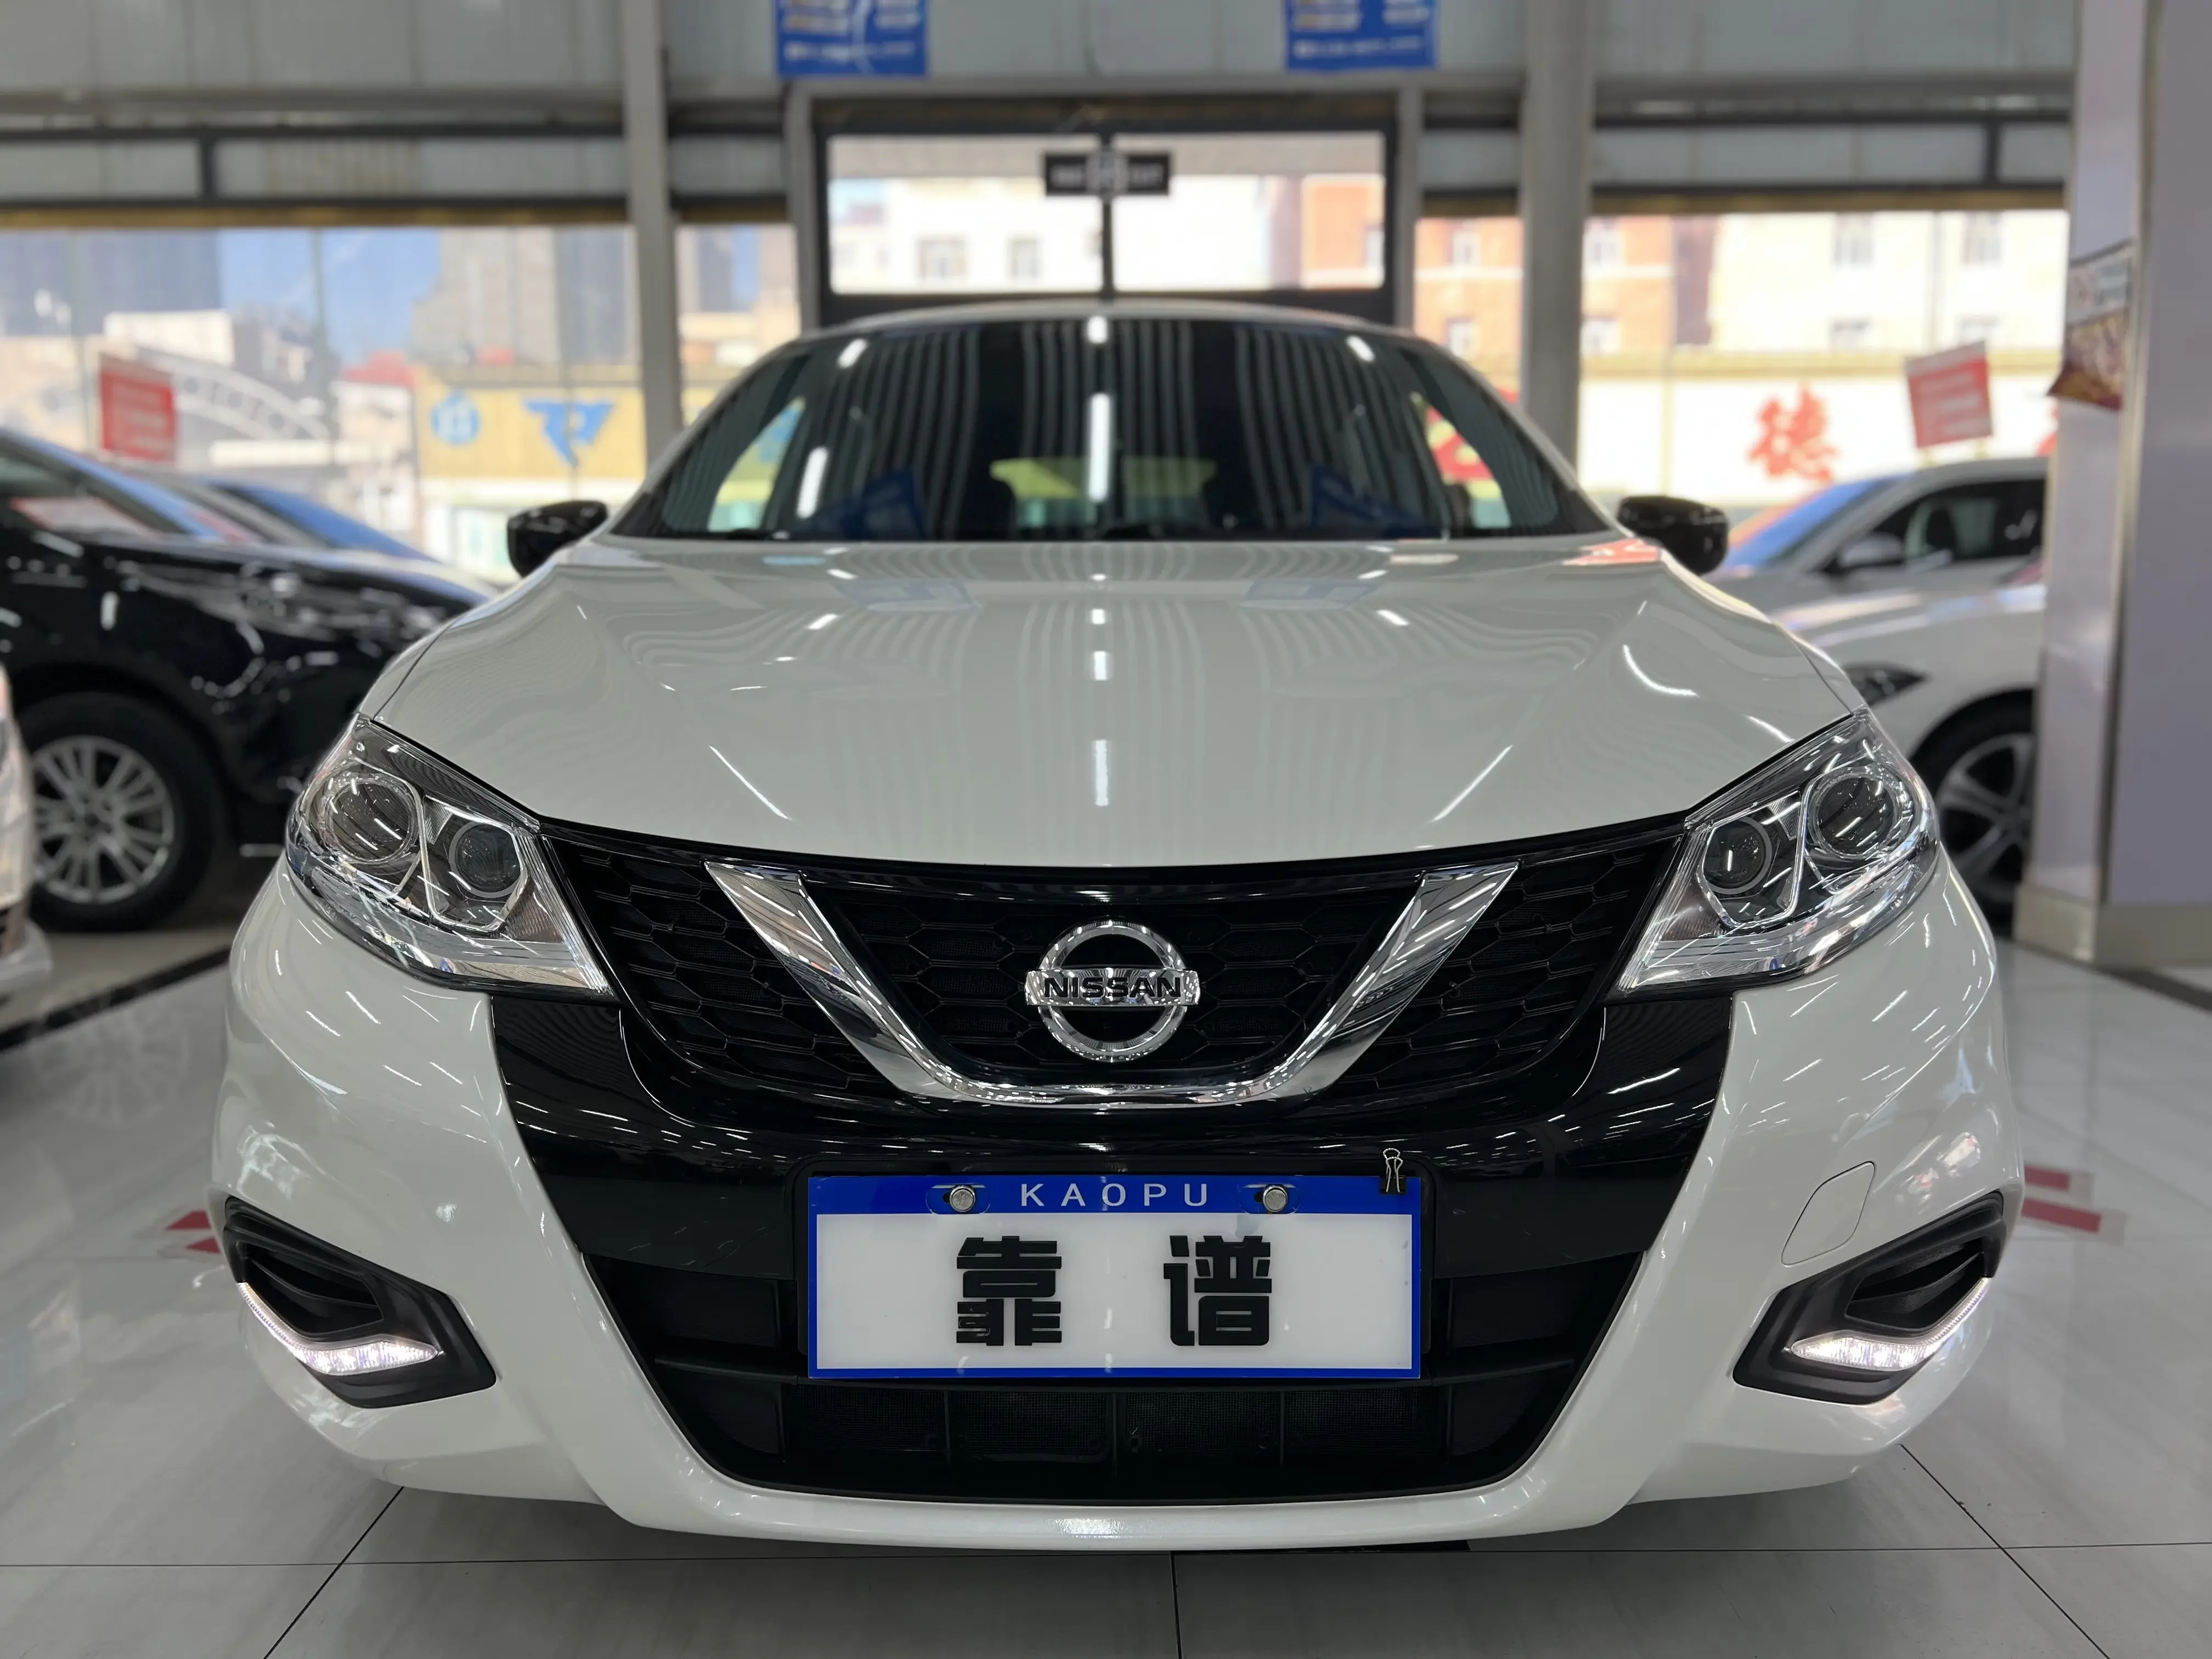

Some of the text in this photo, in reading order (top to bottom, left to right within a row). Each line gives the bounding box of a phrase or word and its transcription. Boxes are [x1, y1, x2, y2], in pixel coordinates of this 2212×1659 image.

[1043, 977, 1181, 998] NISSAN
[1020, 1183, 1207, 1207] KAOPU
[956, 1235, 1272, 1346] 靠谱
